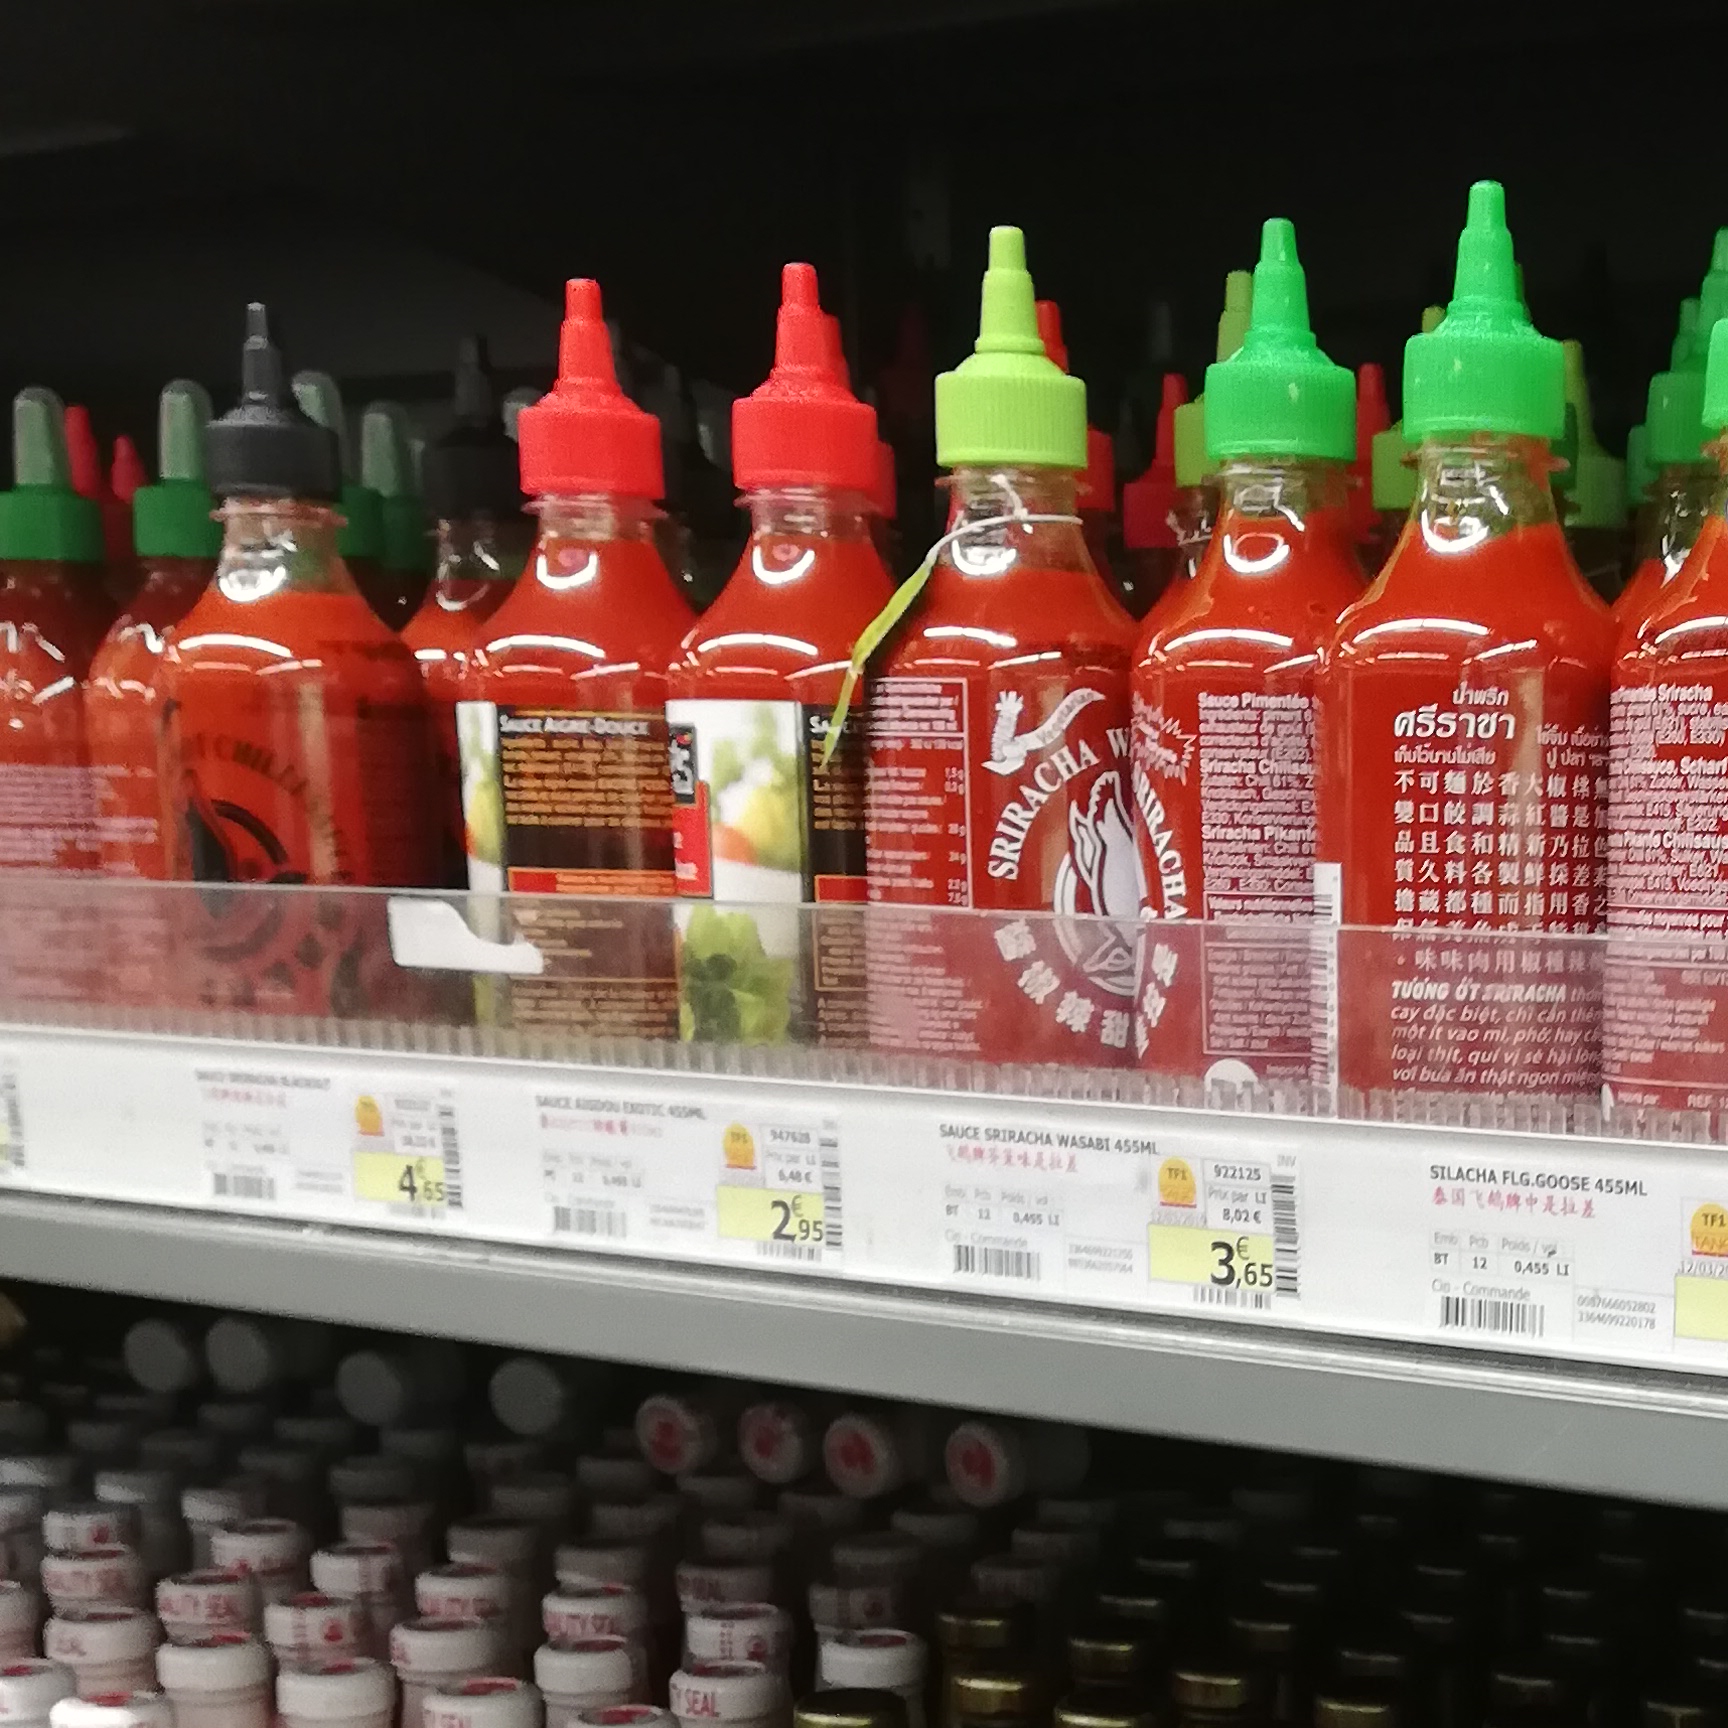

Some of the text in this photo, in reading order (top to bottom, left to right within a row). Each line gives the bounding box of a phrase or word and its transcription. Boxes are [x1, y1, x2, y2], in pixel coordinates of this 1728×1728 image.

[988, 739, 1099, 881] SRIRACHA
[939, 1123, 1160, 1156] SAUCE SRIRACHA WASABI 455ML
[1429, 1164, 1648, 1196] SILACHA FLG.GOOSE 455ML
[1701, 1212, 1727, 1228] TF1
[1472, 1256, 1488, 1270] 12
